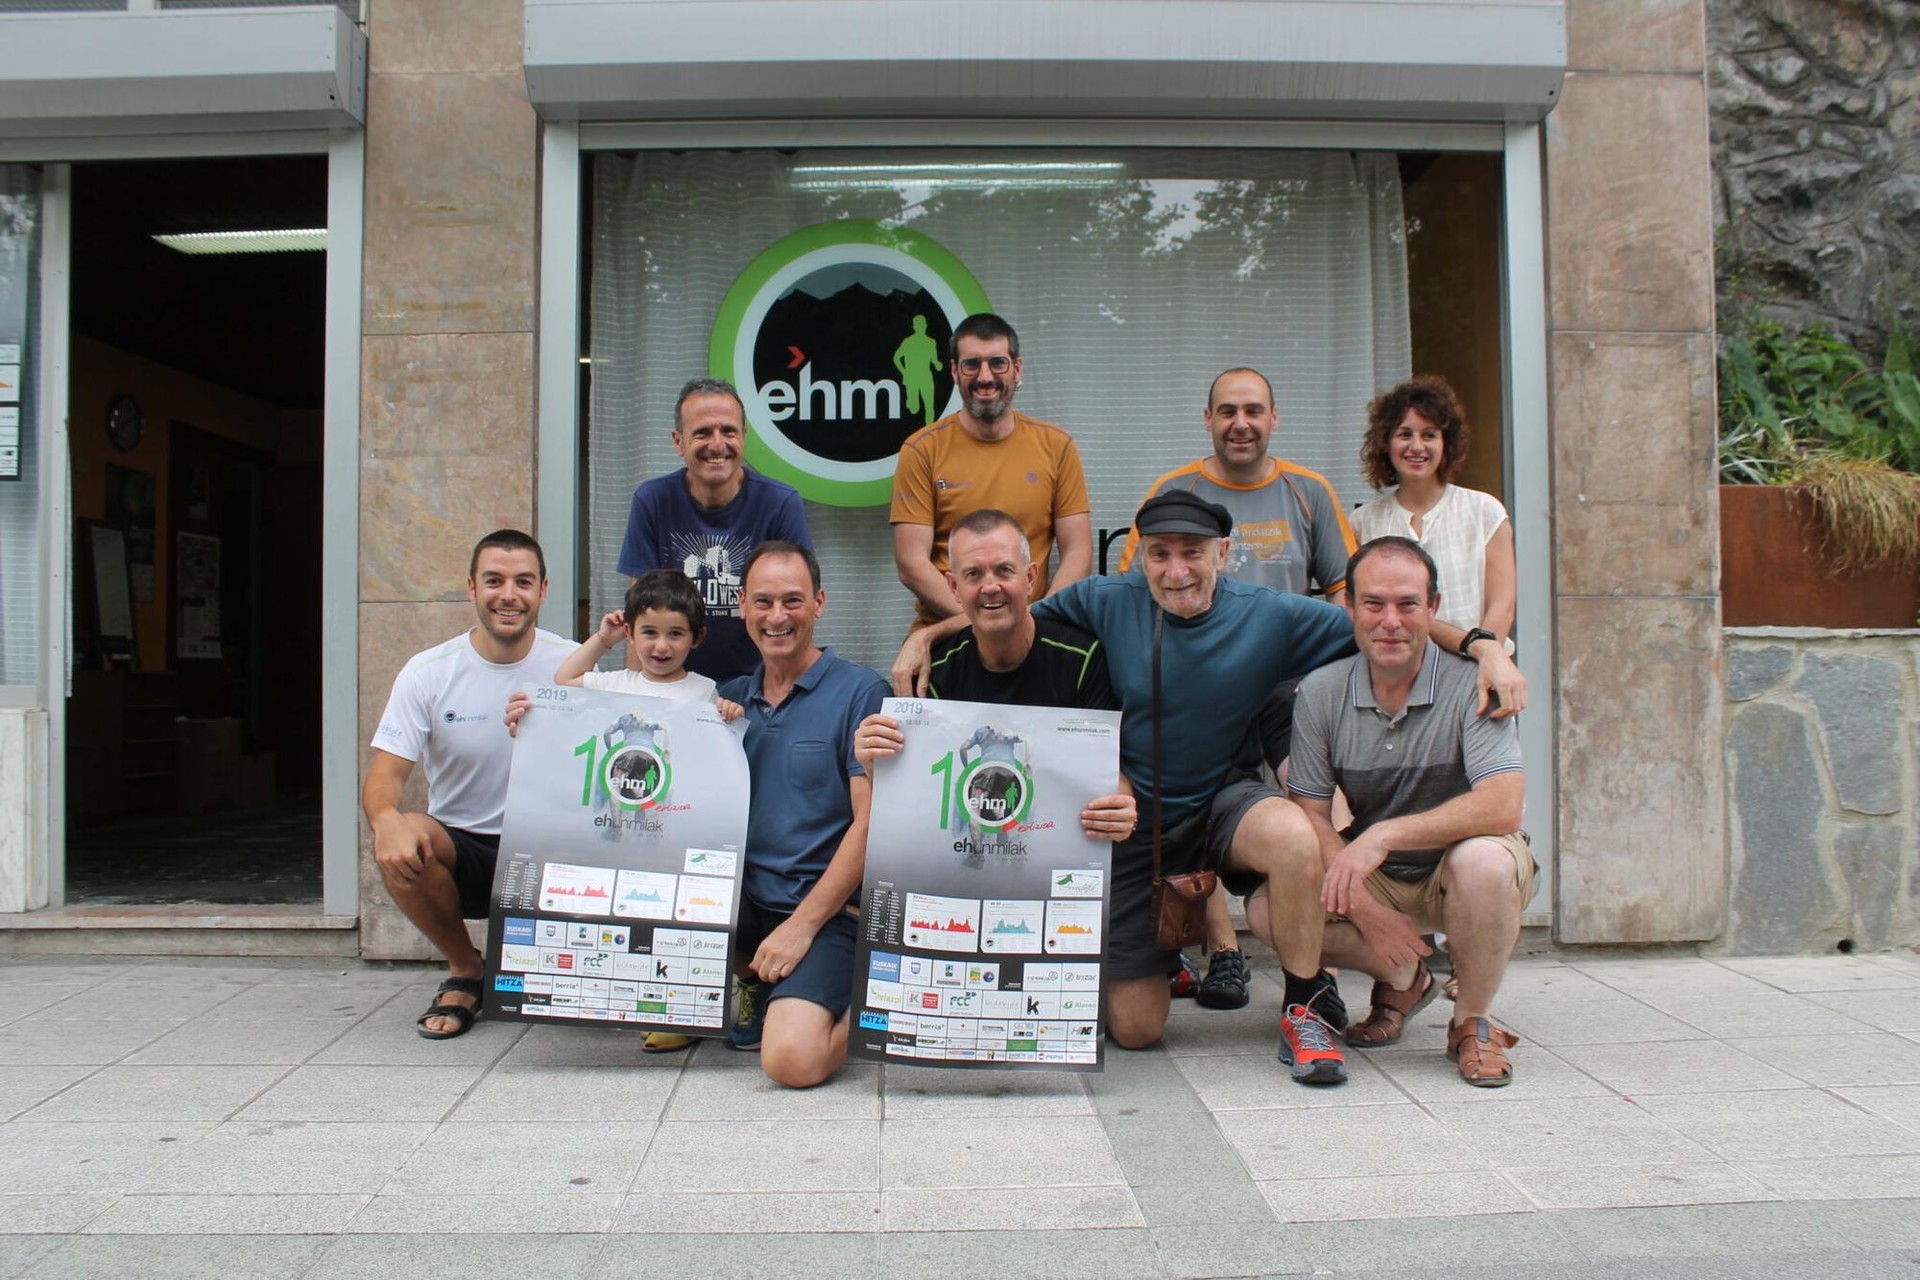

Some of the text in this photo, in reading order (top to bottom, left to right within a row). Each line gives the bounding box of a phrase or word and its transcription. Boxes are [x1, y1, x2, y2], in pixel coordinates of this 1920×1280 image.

[757, 360, 901, 422] ehm
[536, 687, 568, 701] 2019
[893, 701, 924, 715] 2019
[610, 773, 647, 791] ehm
[969, 792, 1007, 811] ehm
[496, 978, 523, 987] HITZA
[861, 1015, 887, 1025] HITZA
